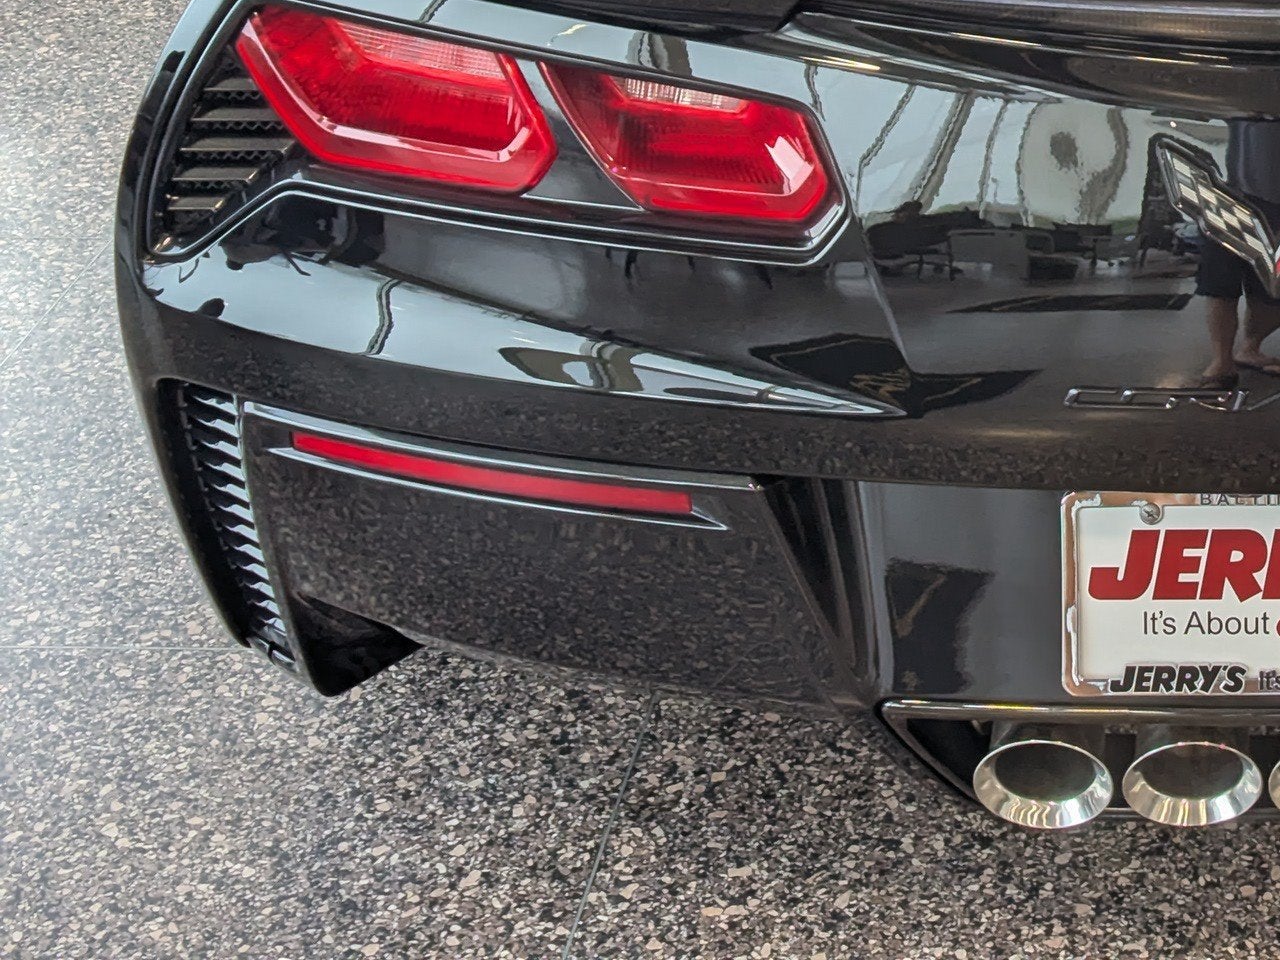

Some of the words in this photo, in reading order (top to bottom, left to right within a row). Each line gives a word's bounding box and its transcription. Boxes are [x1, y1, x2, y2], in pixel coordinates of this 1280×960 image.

[1143, 611, 1177, 635] It's
[1184, 611, 1270, 635] About
[1109, 664, 1247, 694] JERRY'S
